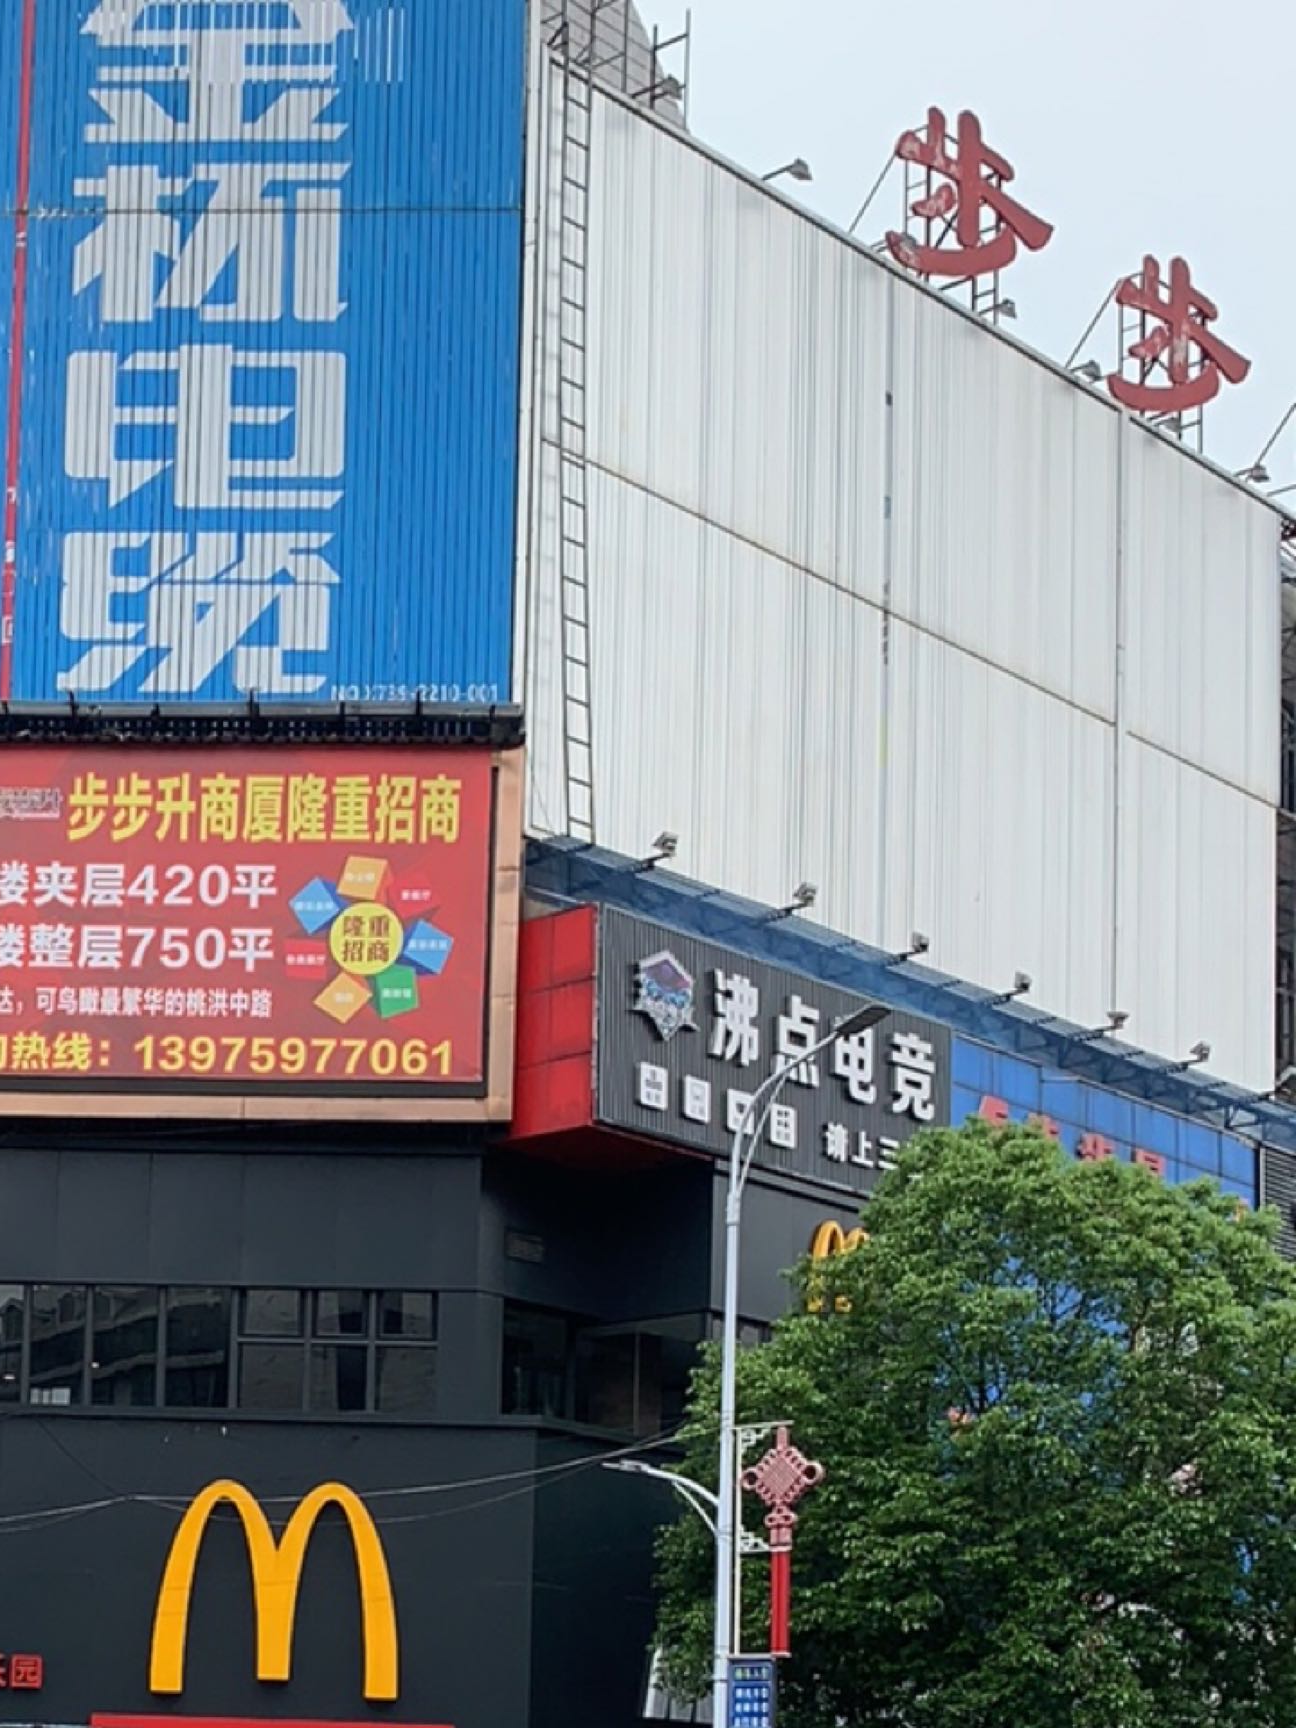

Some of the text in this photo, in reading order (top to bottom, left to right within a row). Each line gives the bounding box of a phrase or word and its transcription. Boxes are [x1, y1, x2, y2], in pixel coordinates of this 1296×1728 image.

[67, 773, 462, 844] 步步升商厦隆重招商
[342, 940, 391, 963] 招商
[708, 967, 936, 1121] 沸点电竞
[824, 1121, 902, 1171] 请上三
